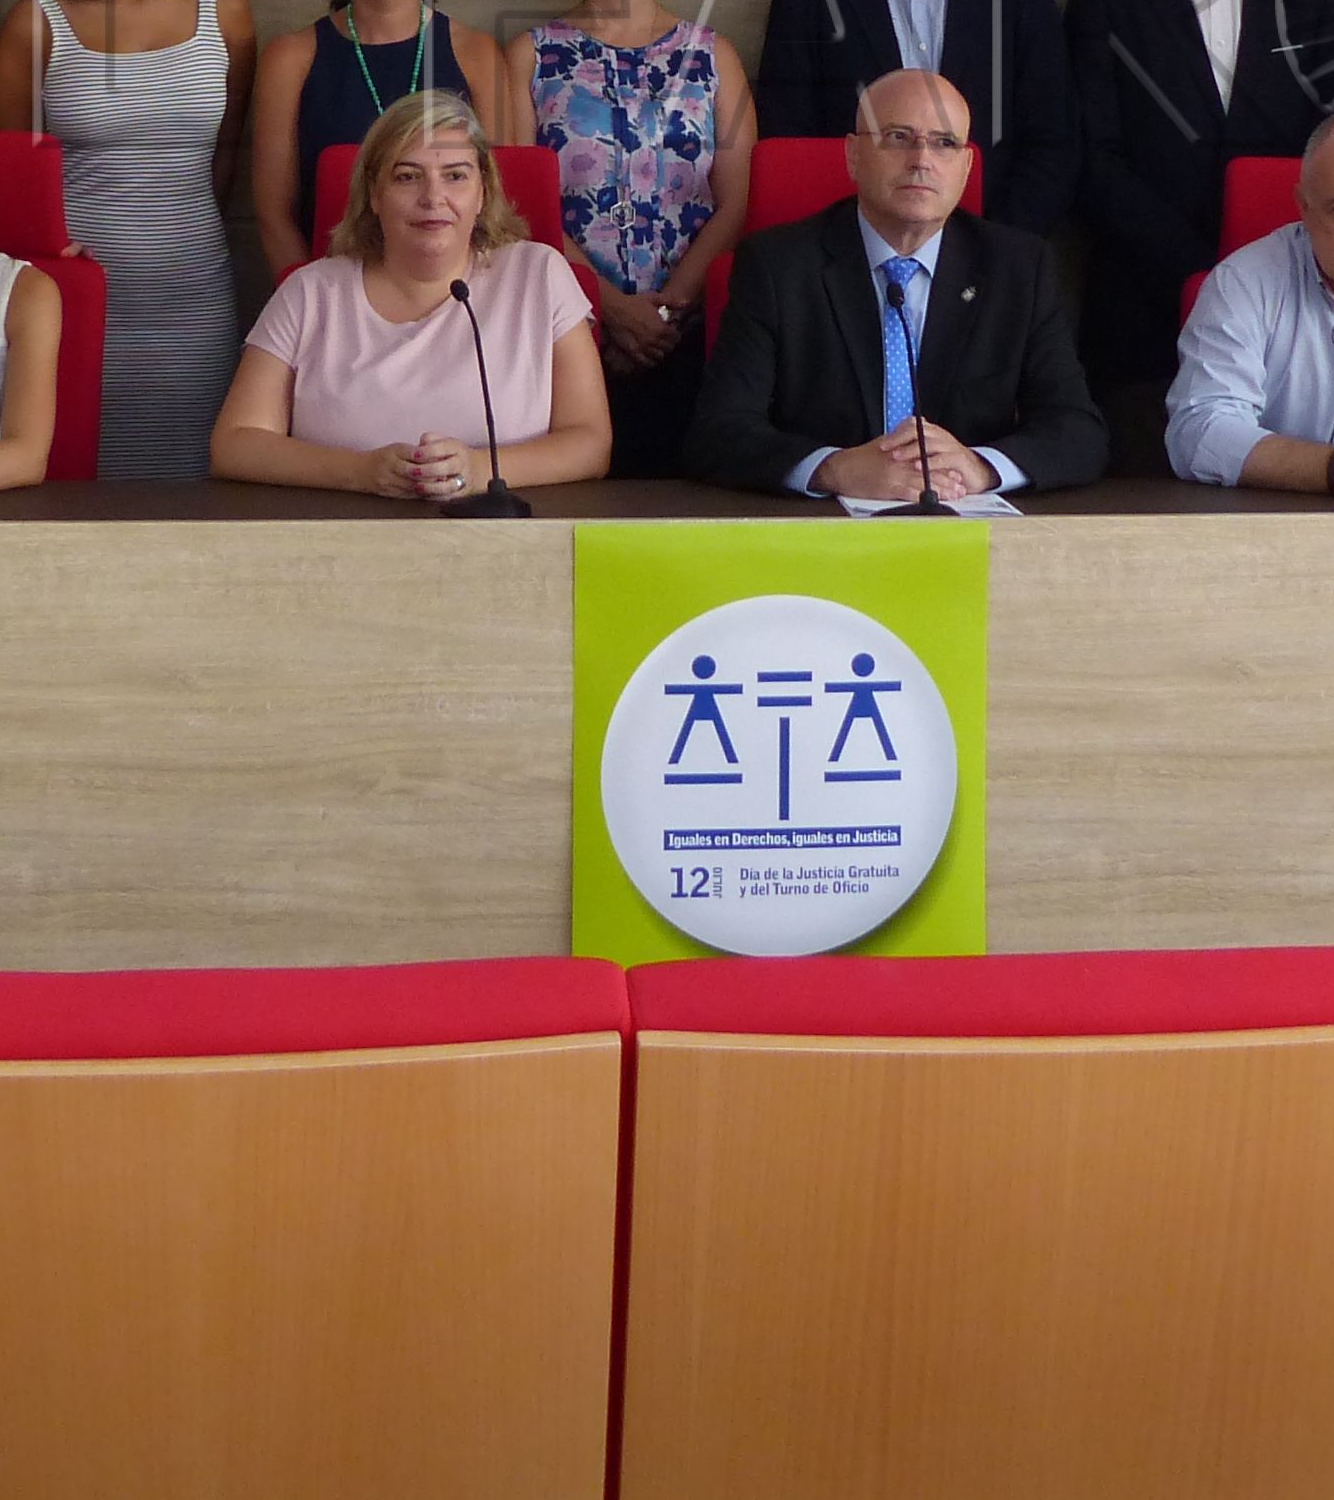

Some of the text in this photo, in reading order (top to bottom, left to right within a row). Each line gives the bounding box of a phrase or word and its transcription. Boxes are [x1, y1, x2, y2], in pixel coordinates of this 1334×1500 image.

[668, 830, 898, 847] Iguales en Derechos, iguales en Justicia
[764, 867, 779, 881] de
[782, 867, 794, 880] la
[796, 866, 845, 880] Justicia
[848, 865, 900, 879] Gratuita
[670, 866, 710, 899] 12
[712, 866, 723, 899] JULIO
[739, 881, 870, 898] y del Turno de Oficio
